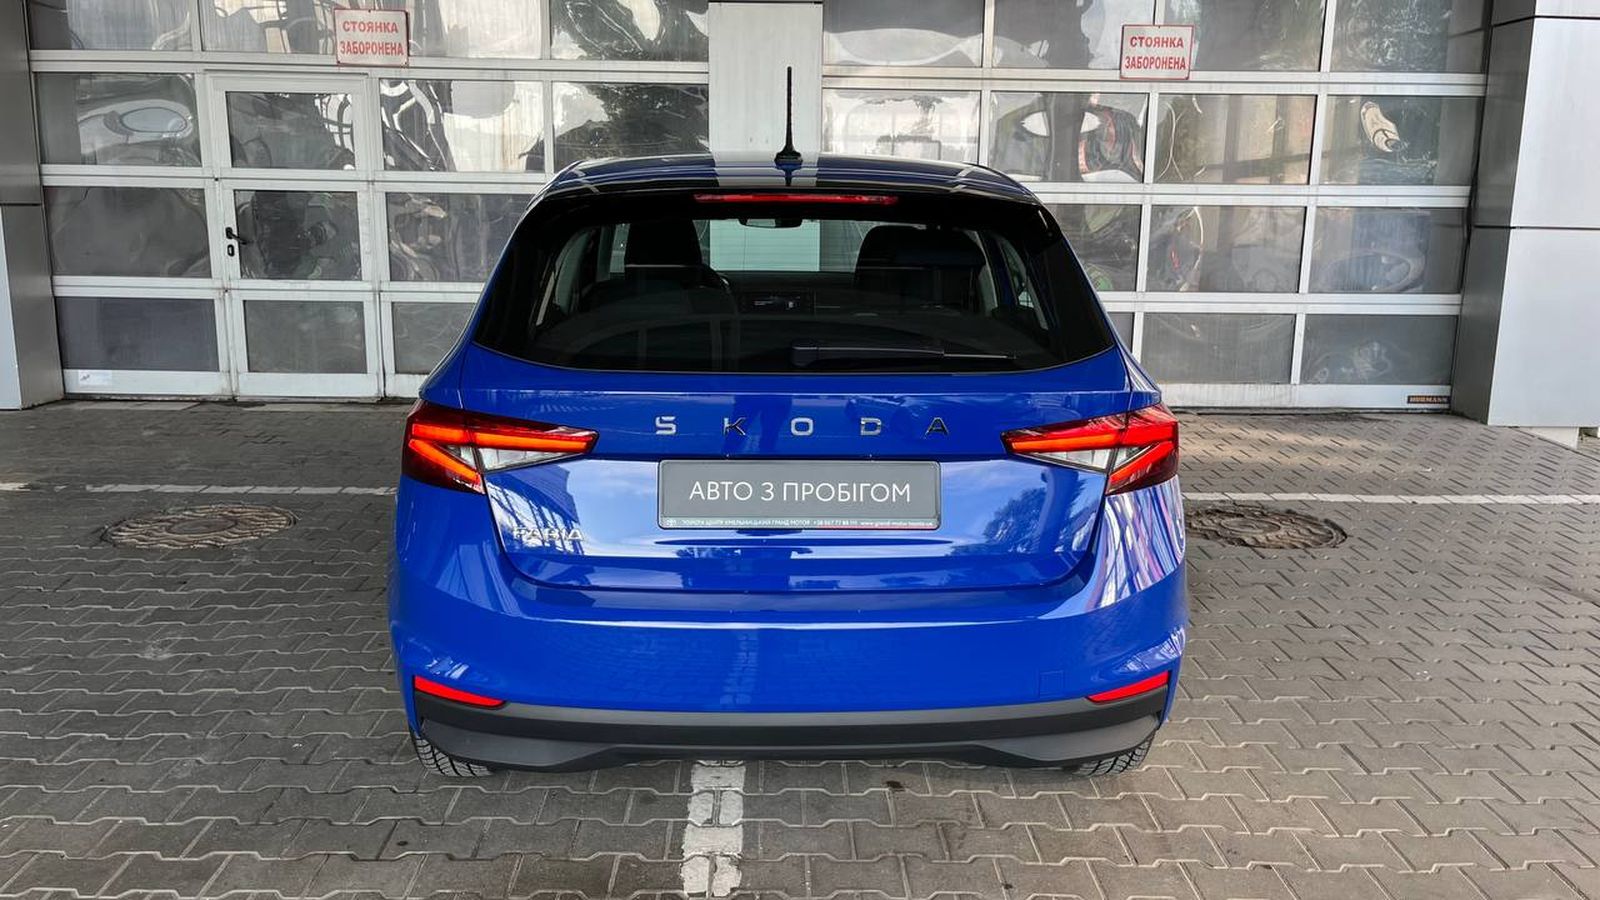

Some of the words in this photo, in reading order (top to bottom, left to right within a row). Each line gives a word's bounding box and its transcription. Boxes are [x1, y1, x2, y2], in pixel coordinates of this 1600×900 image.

[342, 21, 398, 33] СТОЯНКА
[340, 41, 404, 55] ЗАБОРОНЕНА
[1130, 36, 1184, 48] СТОЯНКА
[1125, 56, 1186, 70] ЗАБОРОНЕНА
[689, 481, 753, 501] АВТО
[783, 482, 911, 502] ПРОБІГОМ
[513, 528, 583, 541] FABIA
